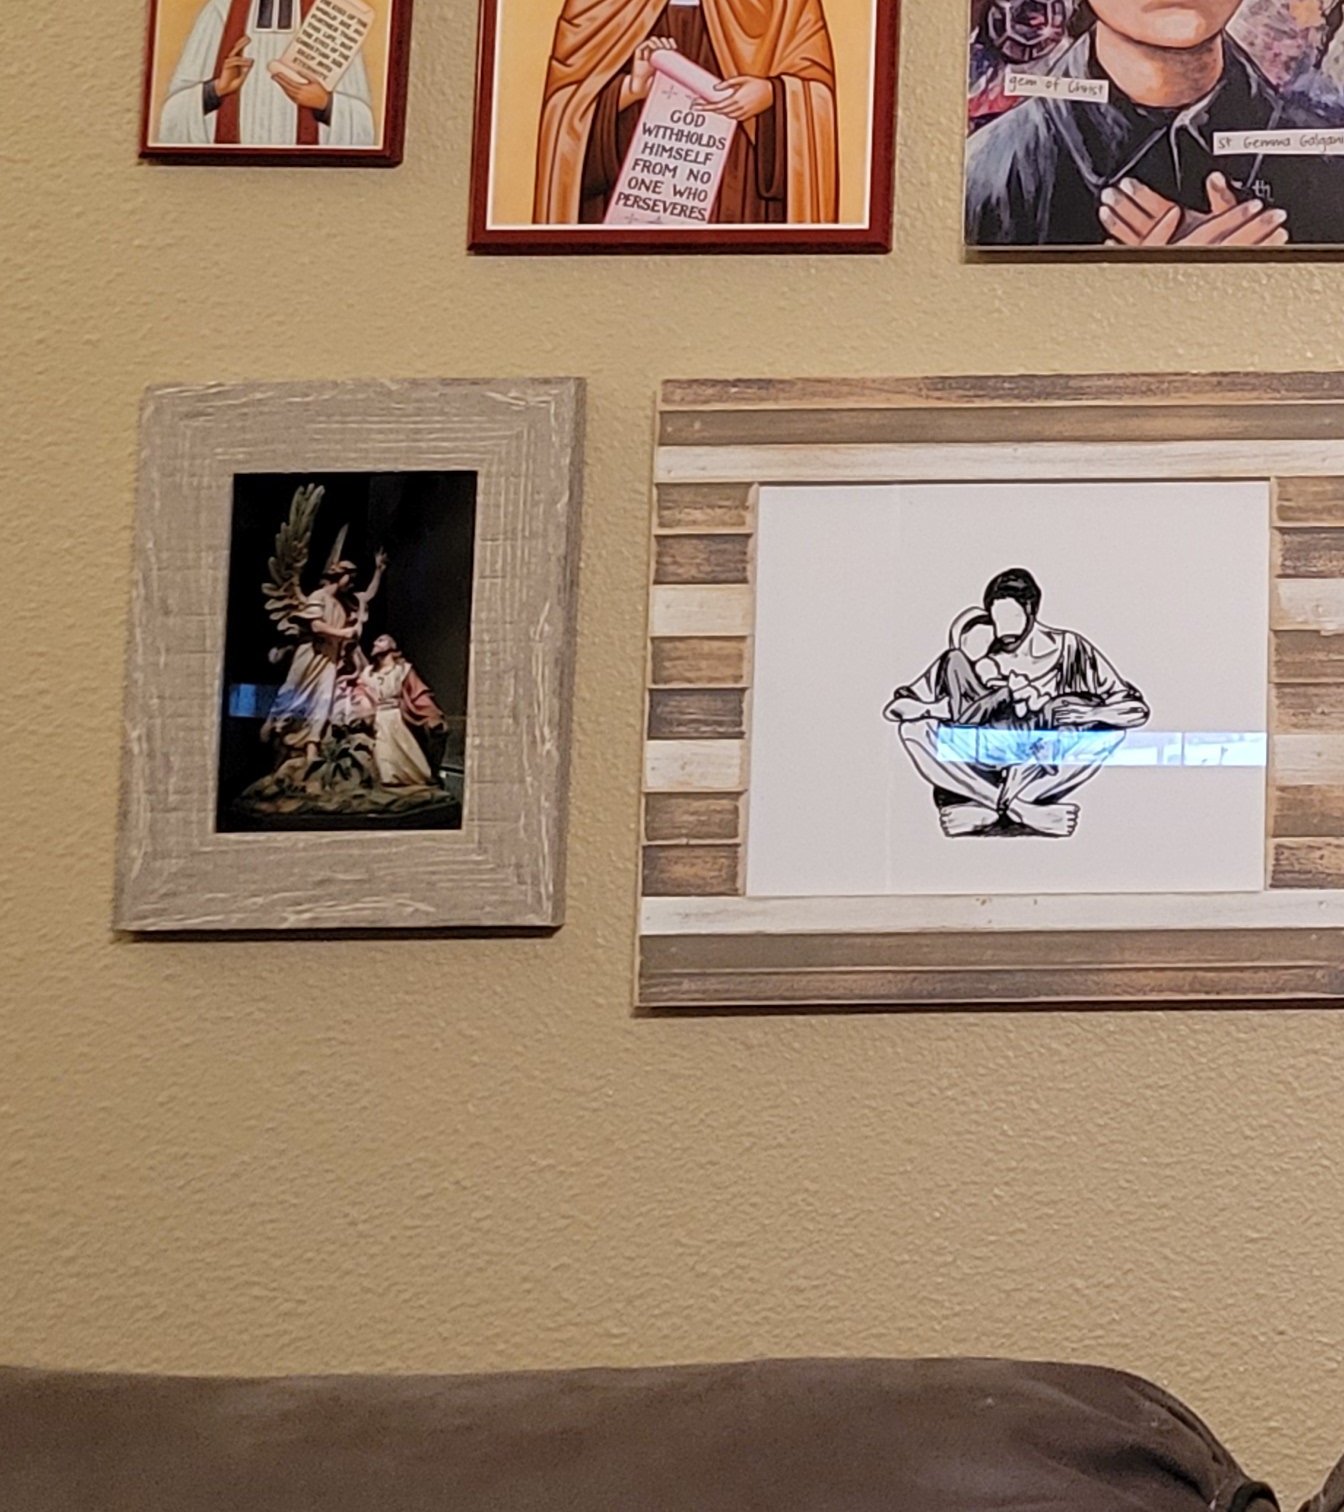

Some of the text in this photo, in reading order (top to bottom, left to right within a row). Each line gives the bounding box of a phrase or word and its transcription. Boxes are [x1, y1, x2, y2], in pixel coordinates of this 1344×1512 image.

[1009, 76, 1104, 96] gem of Christ
[670, 109, 706, 128] GOD
[641, 122, 727, 151] WITHHOLDS
[1243, 137, 1291, 149] Gemma
[1300, 133, 1344, 152] Galgani
[641, 141, 714, 166] HIMSELF
[631, 157, 712, 185] FROM NO
[627, 176, 708, 203] ONE WHO
[614, 191, 708, 222] PERSEVERES
